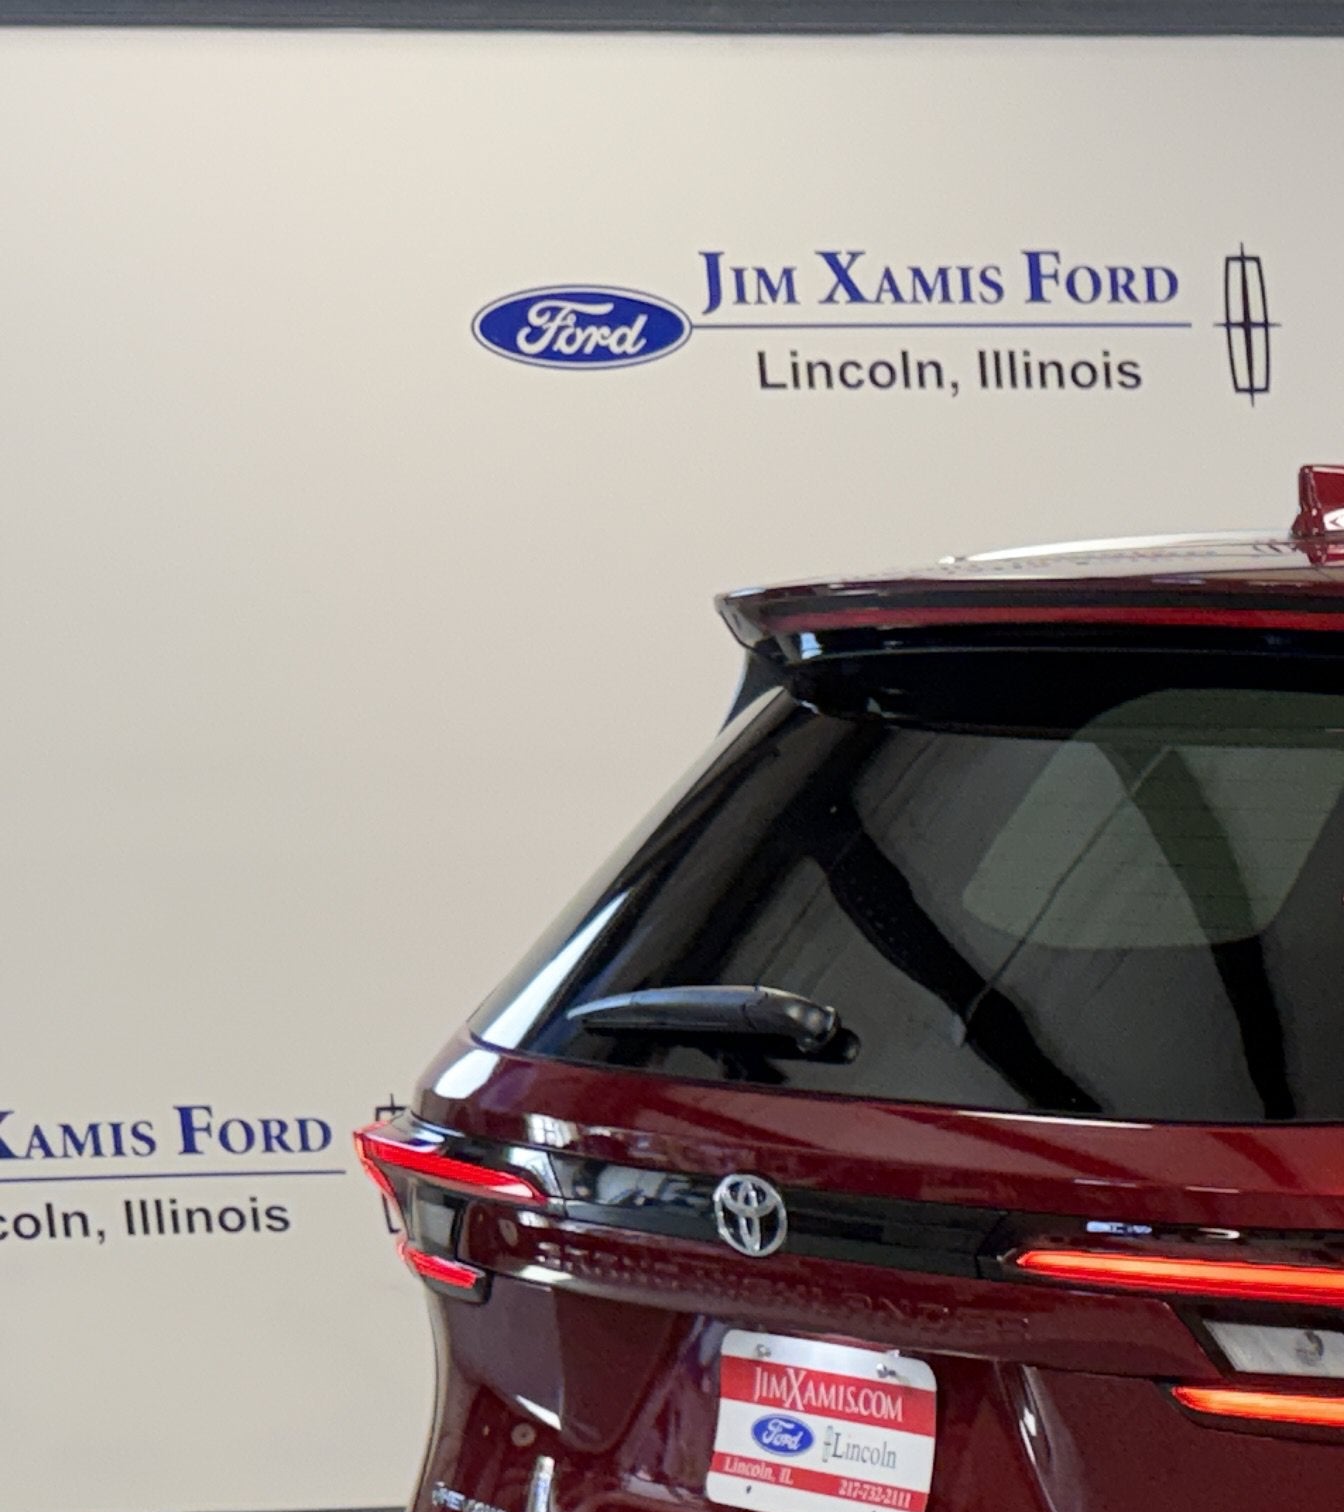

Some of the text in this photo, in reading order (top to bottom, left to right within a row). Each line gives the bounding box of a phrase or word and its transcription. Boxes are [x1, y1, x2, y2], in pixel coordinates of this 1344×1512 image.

[515, 299, 647, 356] Ford
[757, 348, 1143, 398] Lincoln, Illinois
[123, 1196, 291, 1236] Illinois
[761, 1418, 804, 1451] Ford
[831, 1432, 898, 1470] Lincoln
